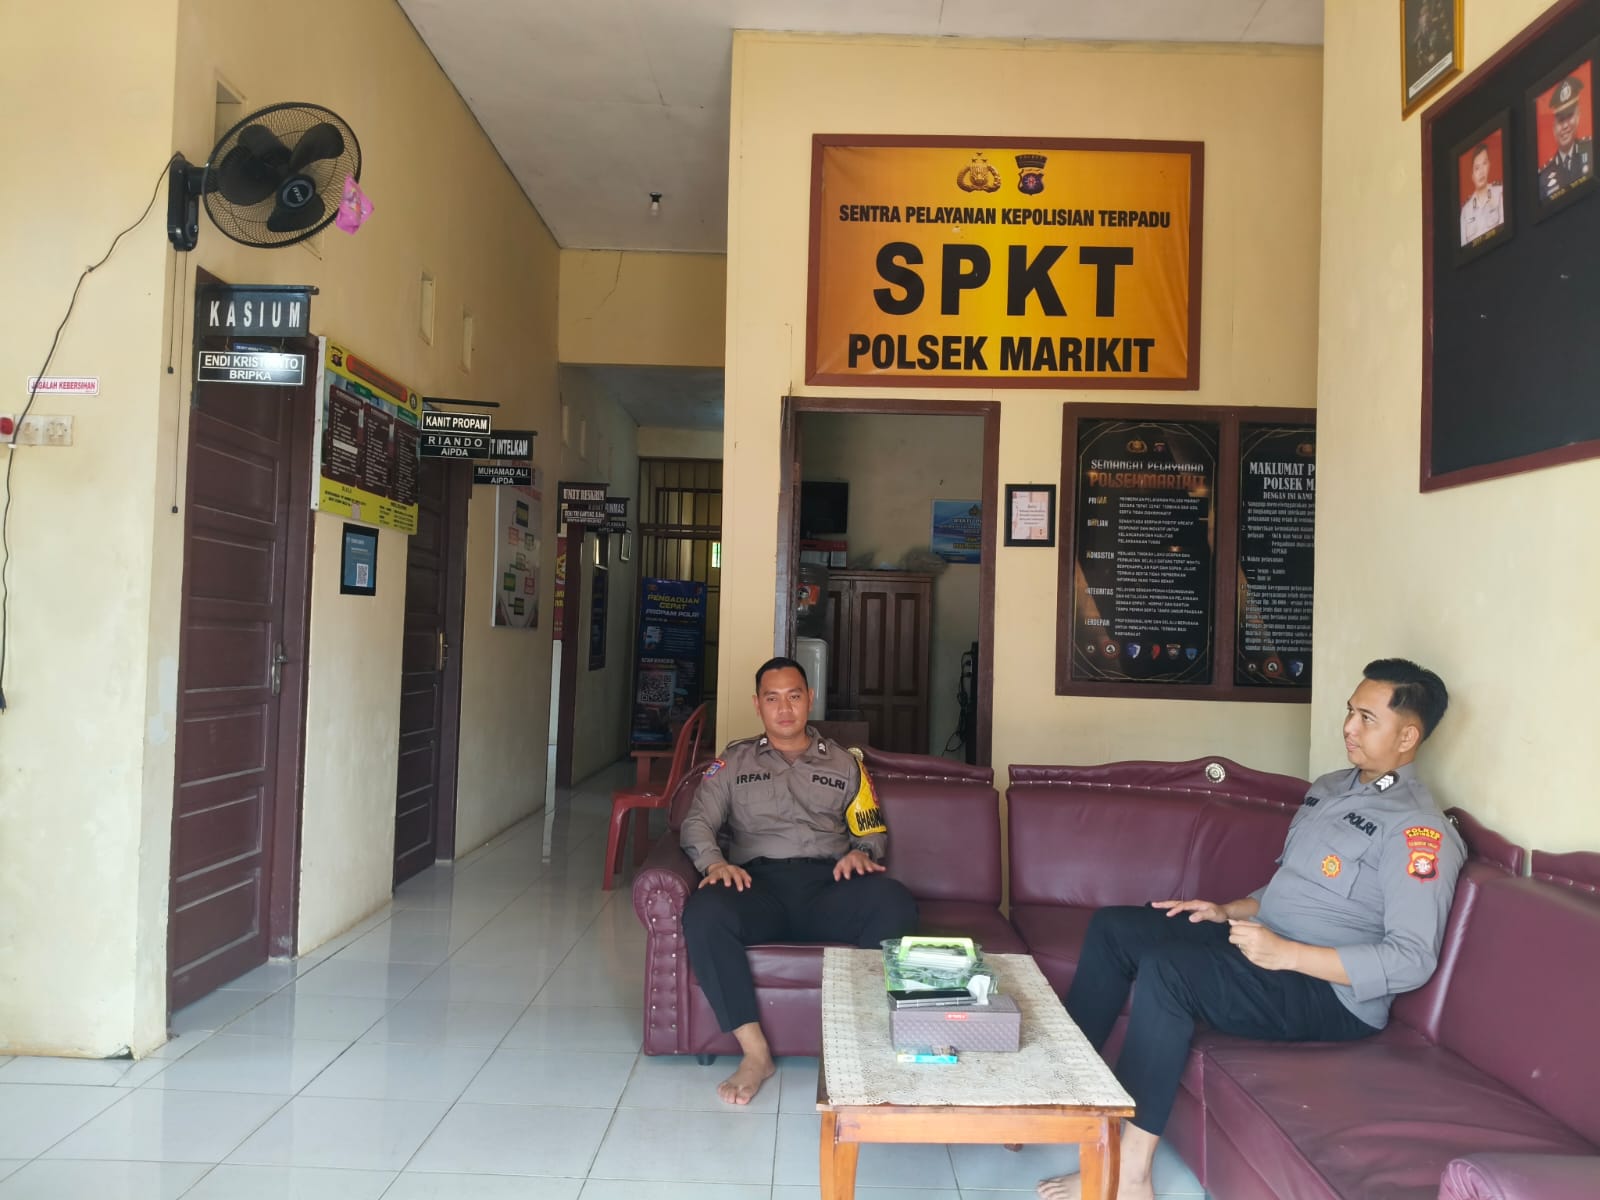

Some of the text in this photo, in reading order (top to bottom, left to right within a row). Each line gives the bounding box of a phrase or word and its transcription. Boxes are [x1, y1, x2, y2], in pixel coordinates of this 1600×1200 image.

[839, 204, 1171, 228] SENTRA PELAYANAN KEPOLISIAN TERPADU
[873, 241, 1134, 317] SPKT
[209, 300, 301, 328] KASIUM
[848, 333, 1155, 373] POLSEK MARIKIT
[205, 355, 231, 367] ENDI
[229, 370, 272, 381] BRIPKA
[59, 381, 96, 390] KEBERSIHAN
[425, 415, 488, 430] KANIT PROPAM
[428, 436, 483, 447] RIANDO
[496, 439, 528, 456] INTELKAM
[440, 448, 468, 457] AIPDA
[477, 467, 528, 477] MUHAMAD ALI
[1249, 462, 1304, 476] MAKLUMAT
[490, 477, 514, 485] AIPDA
[1263, 477, 1303, 491] POLSEK
[1263, 491, 1286, 500] DENGAN
[736, 772, 771, 785] IRFAN
[812, 774, 846, 791] POLRI
[1343, 812, 1378, 837] POLRI
